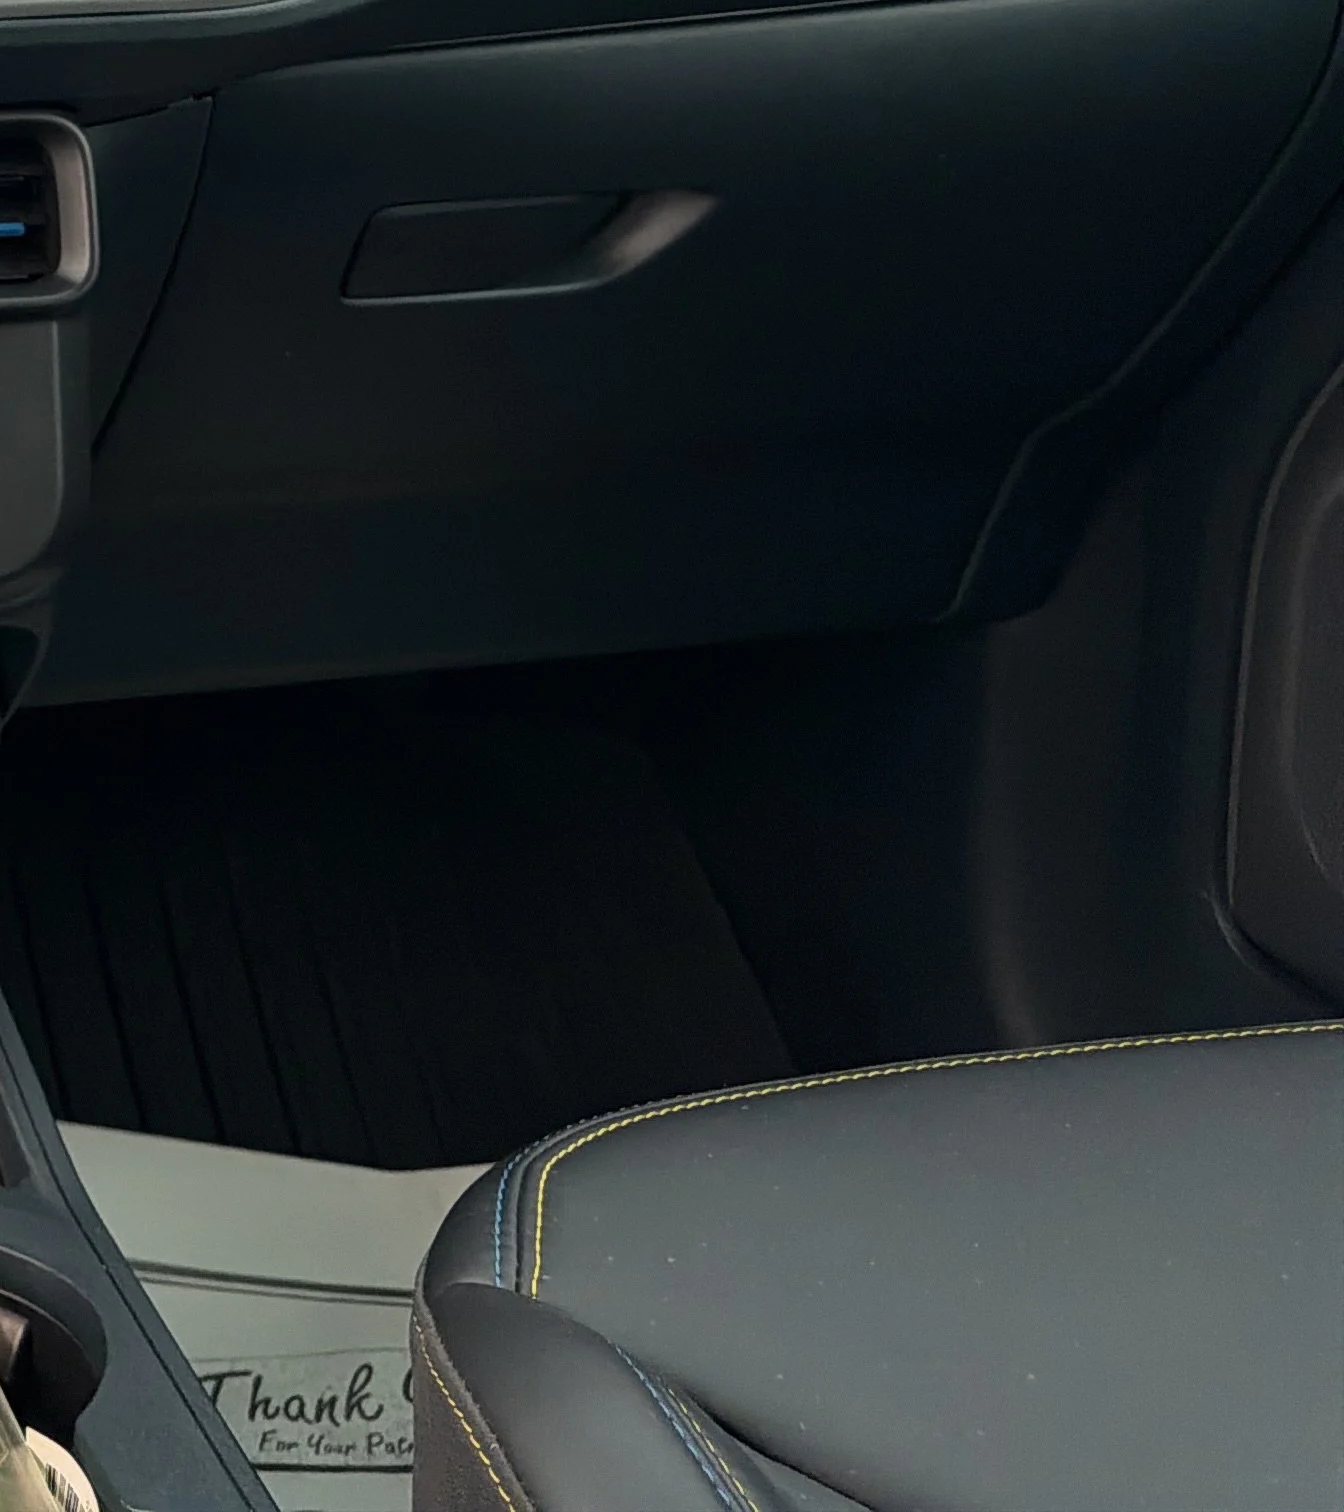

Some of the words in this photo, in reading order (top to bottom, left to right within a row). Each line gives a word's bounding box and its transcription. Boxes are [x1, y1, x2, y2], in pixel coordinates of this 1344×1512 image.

[198, 1362, 385, 1428] Thank
[258, 1429, 300, 1452] For
[306, 1432, 357, 1456] Your
